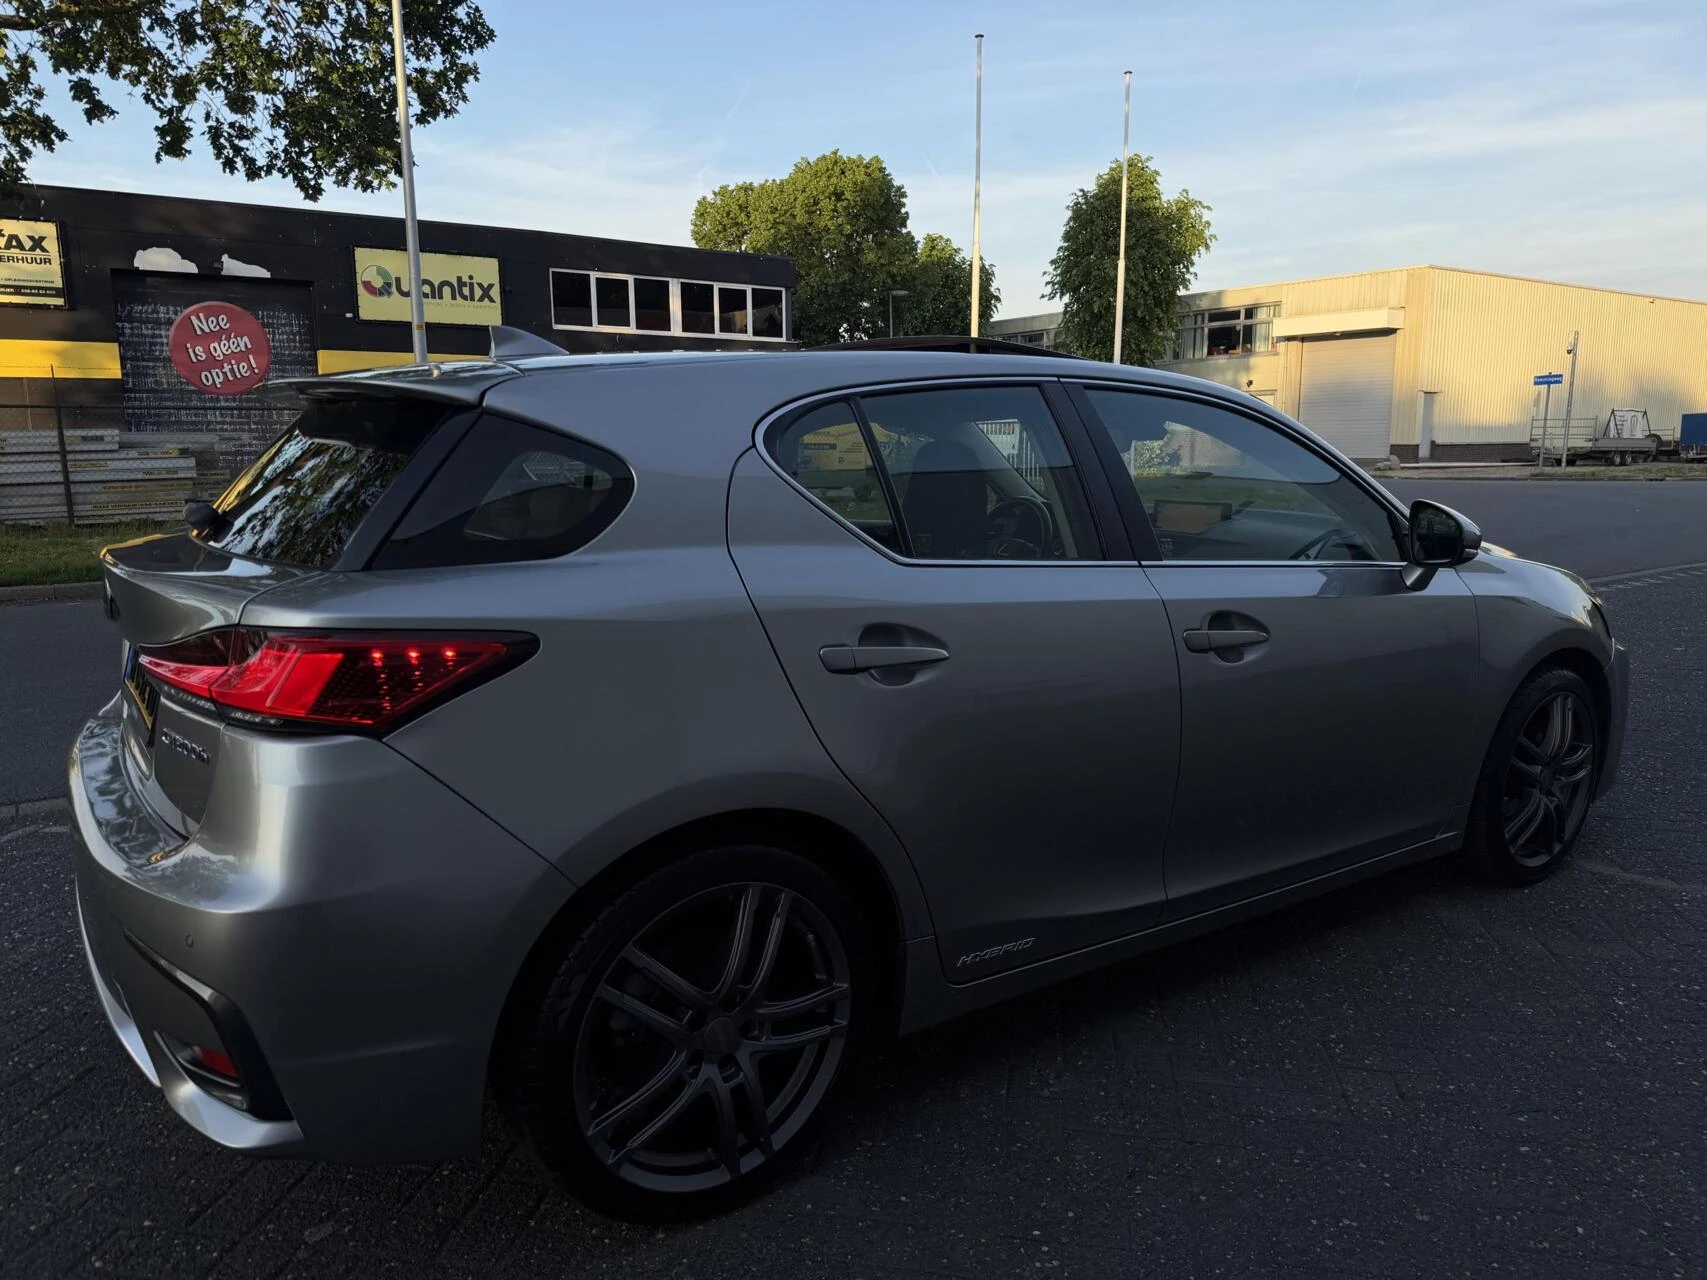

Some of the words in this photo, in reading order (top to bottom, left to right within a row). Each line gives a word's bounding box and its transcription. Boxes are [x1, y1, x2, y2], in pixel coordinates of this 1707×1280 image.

[361, 265, 496, 304] Quantix
[189, 312, 230, 336] Nee
[186, 343, 206, 363] is
[209, 332, 252, 361] géén
